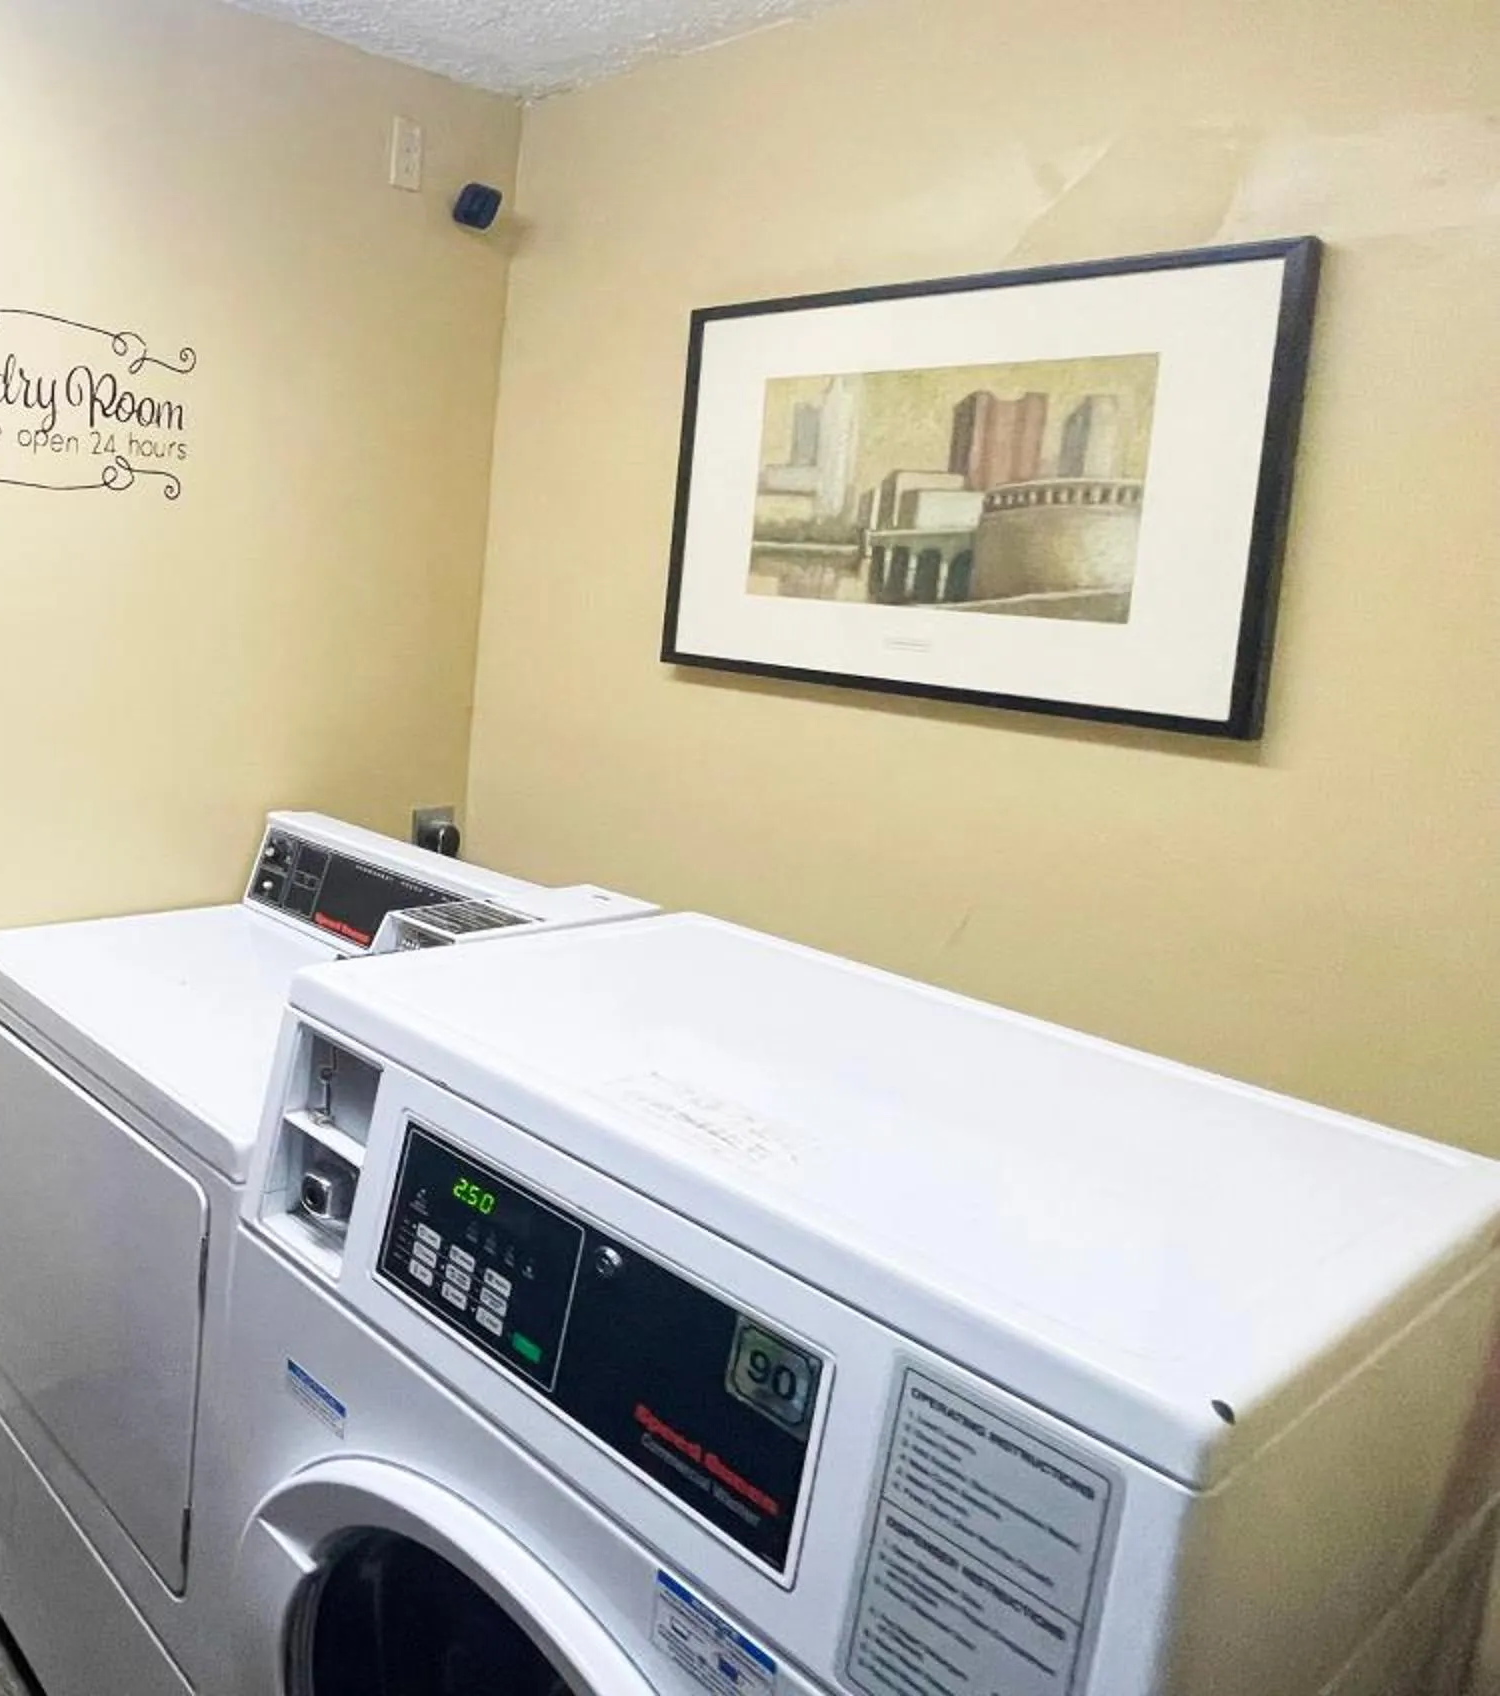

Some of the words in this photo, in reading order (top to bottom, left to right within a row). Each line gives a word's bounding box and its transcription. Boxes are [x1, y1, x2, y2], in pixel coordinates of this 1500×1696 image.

[65, 365, 183, 430] Room
[16, 429, 79, 454] open
[90, 430, 117, 455] 24
[128, 431, 188, 460] hours
[747, 1349, 797, 1401] 90
[911, 1387, 987, 1437] OPERATING
[987, 1431, 1096, 1501] INSTRUCTIONS
